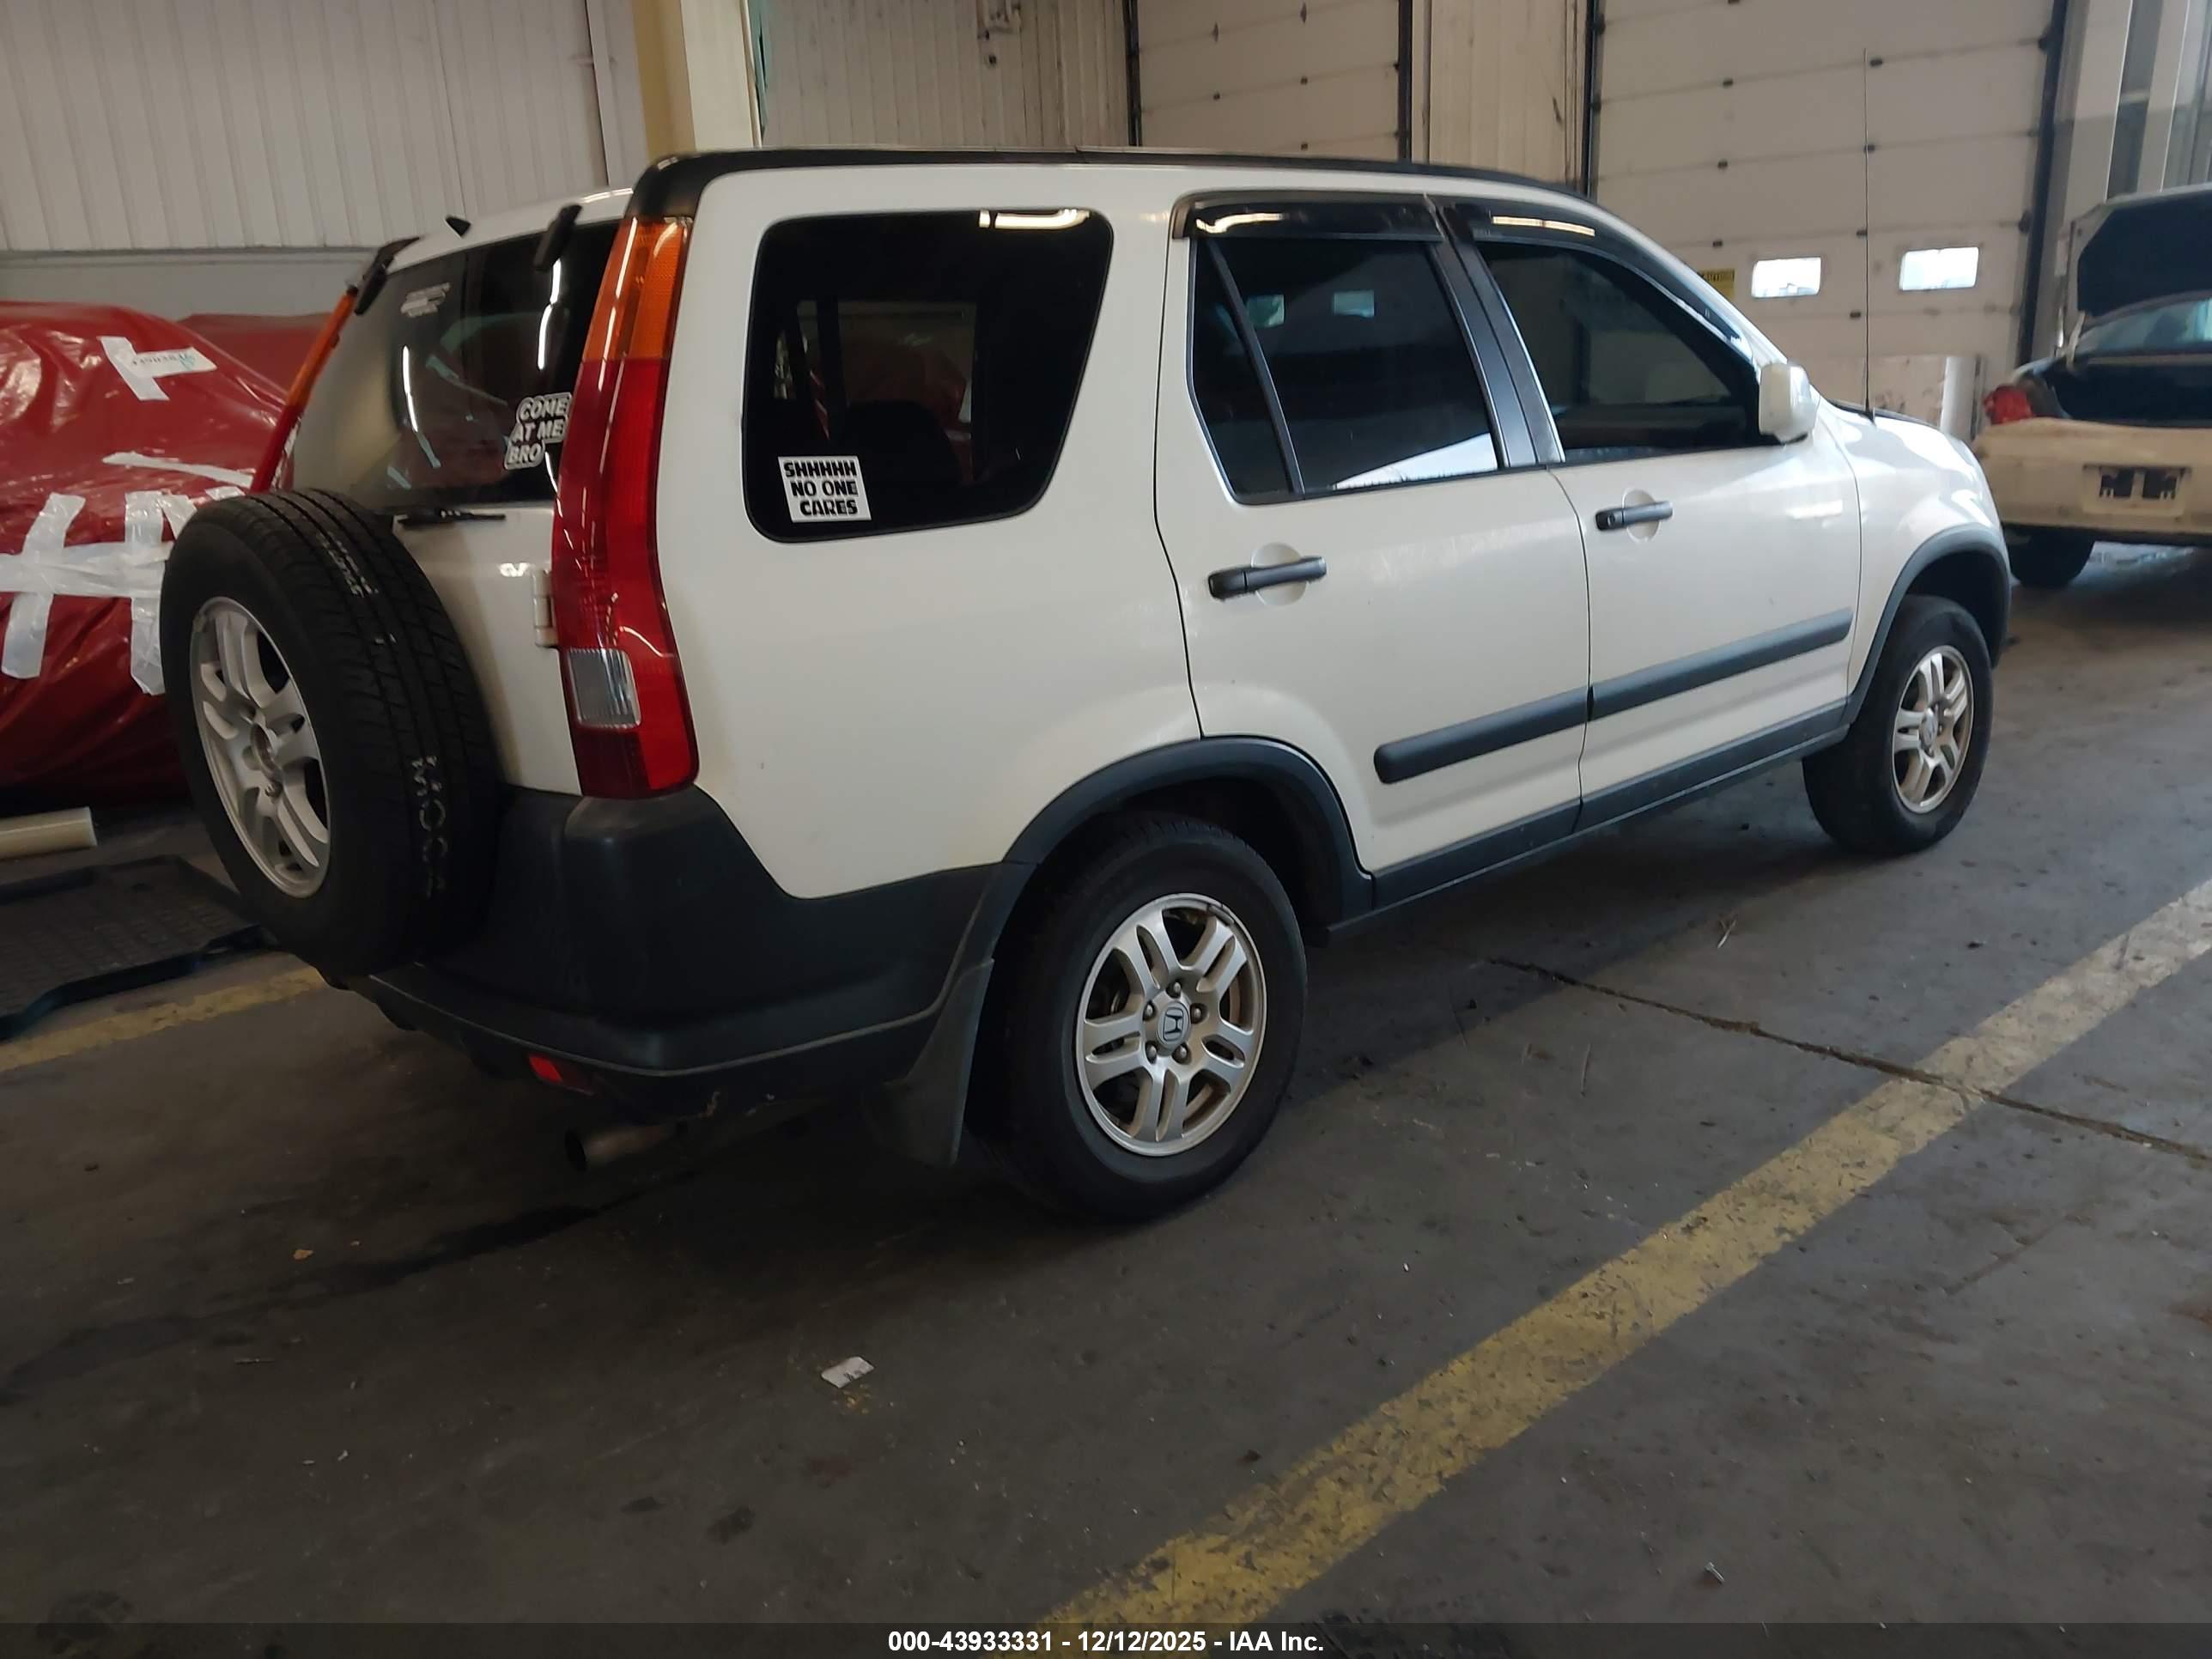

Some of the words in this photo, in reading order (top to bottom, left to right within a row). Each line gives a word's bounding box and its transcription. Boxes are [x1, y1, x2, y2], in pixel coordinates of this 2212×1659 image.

[519, 397, 567, 421] COME
[510, 422, 536, 443] AT
[536, 417, 565, 441] ME
[507, 442, 542, 465] BRO
[783, 461, 858, 478] SHHHHH
[790, 480, 817, 497] NO
[821, 479, 860, 496] ONE
[799, 499, 859, 517] CARES
